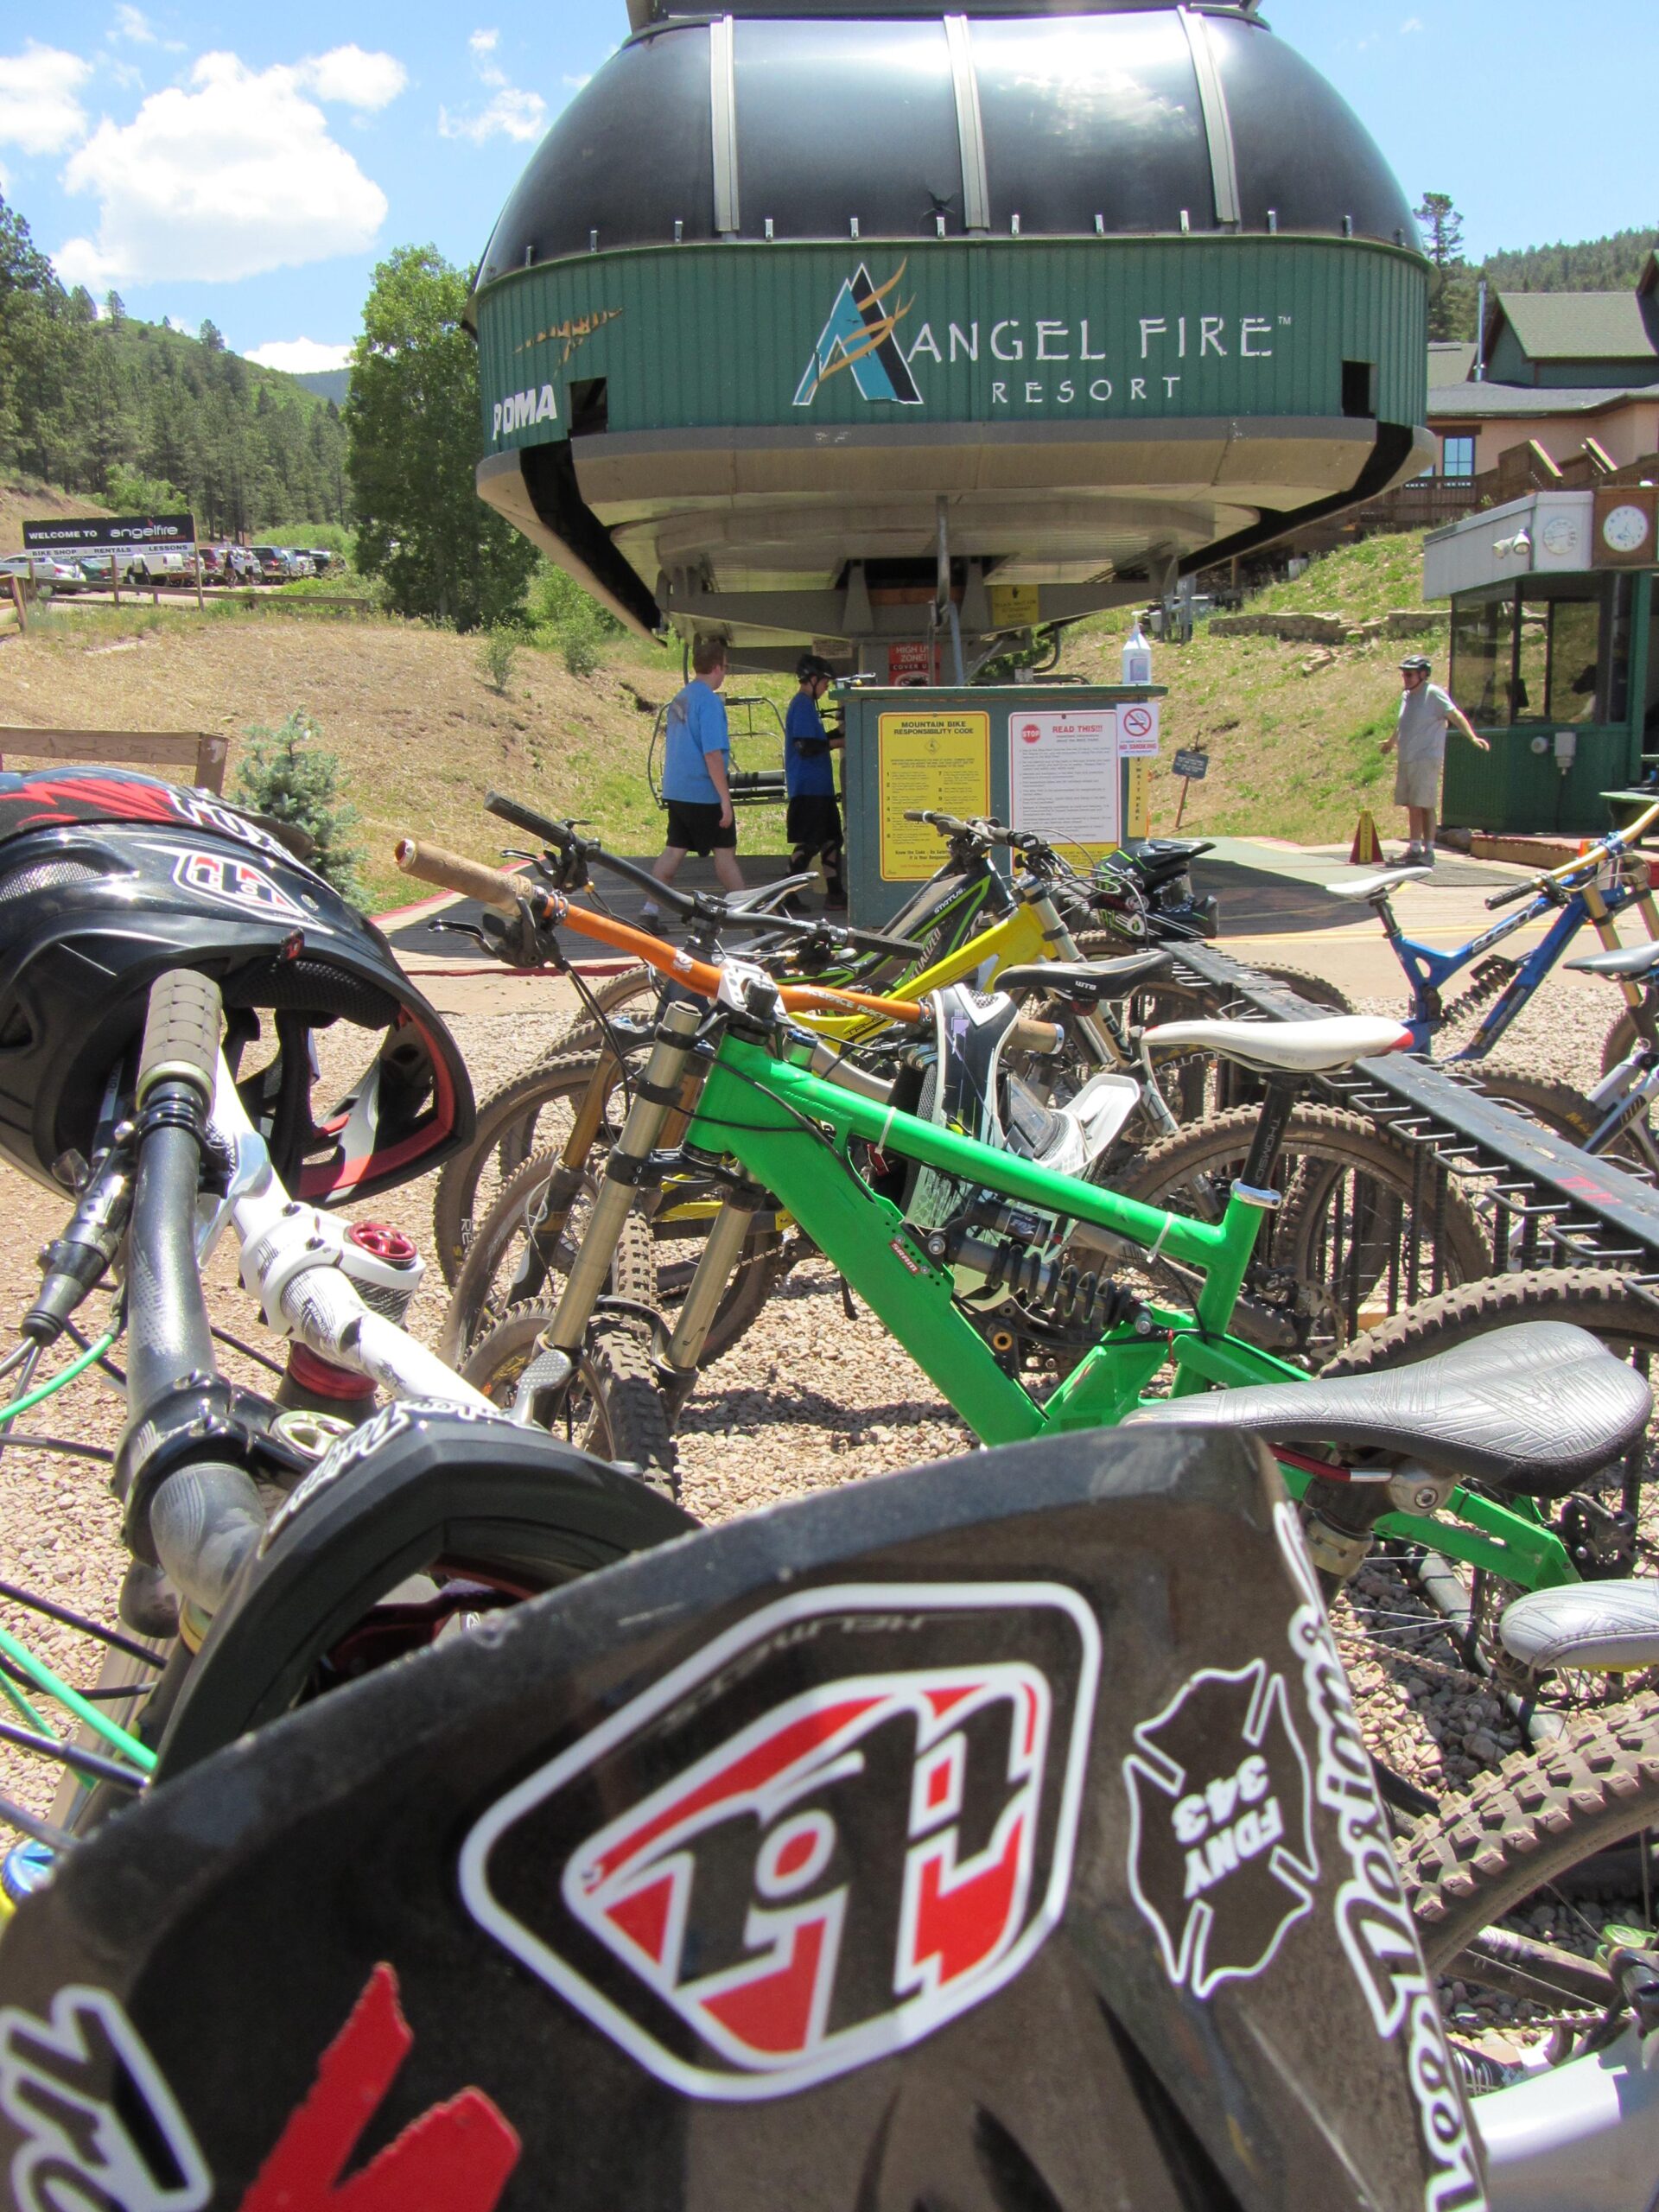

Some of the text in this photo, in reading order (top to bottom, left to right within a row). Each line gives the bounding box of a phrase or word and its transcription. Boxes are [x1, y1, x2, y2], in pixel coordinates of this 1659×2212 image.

[907, 319, 1107, 364] ANGEL
[1139, 316, 1272, 359] FIRE
[992, 376, 1180, 404] RESORT
[492, 384, 557, 441] POMA
[29, 531, 80, 539] WELCOME
[110, 524, 179, 539] angelfire
[934, 887, 963, 914] STATUS
[1255, 1117, 1281, 1182] THOMSO
[891, 1243, 918, 1273] SRAM
[1172, 1754, 1270, 1845] 343
[1183, 1797, 1284, 1898] FDNY
